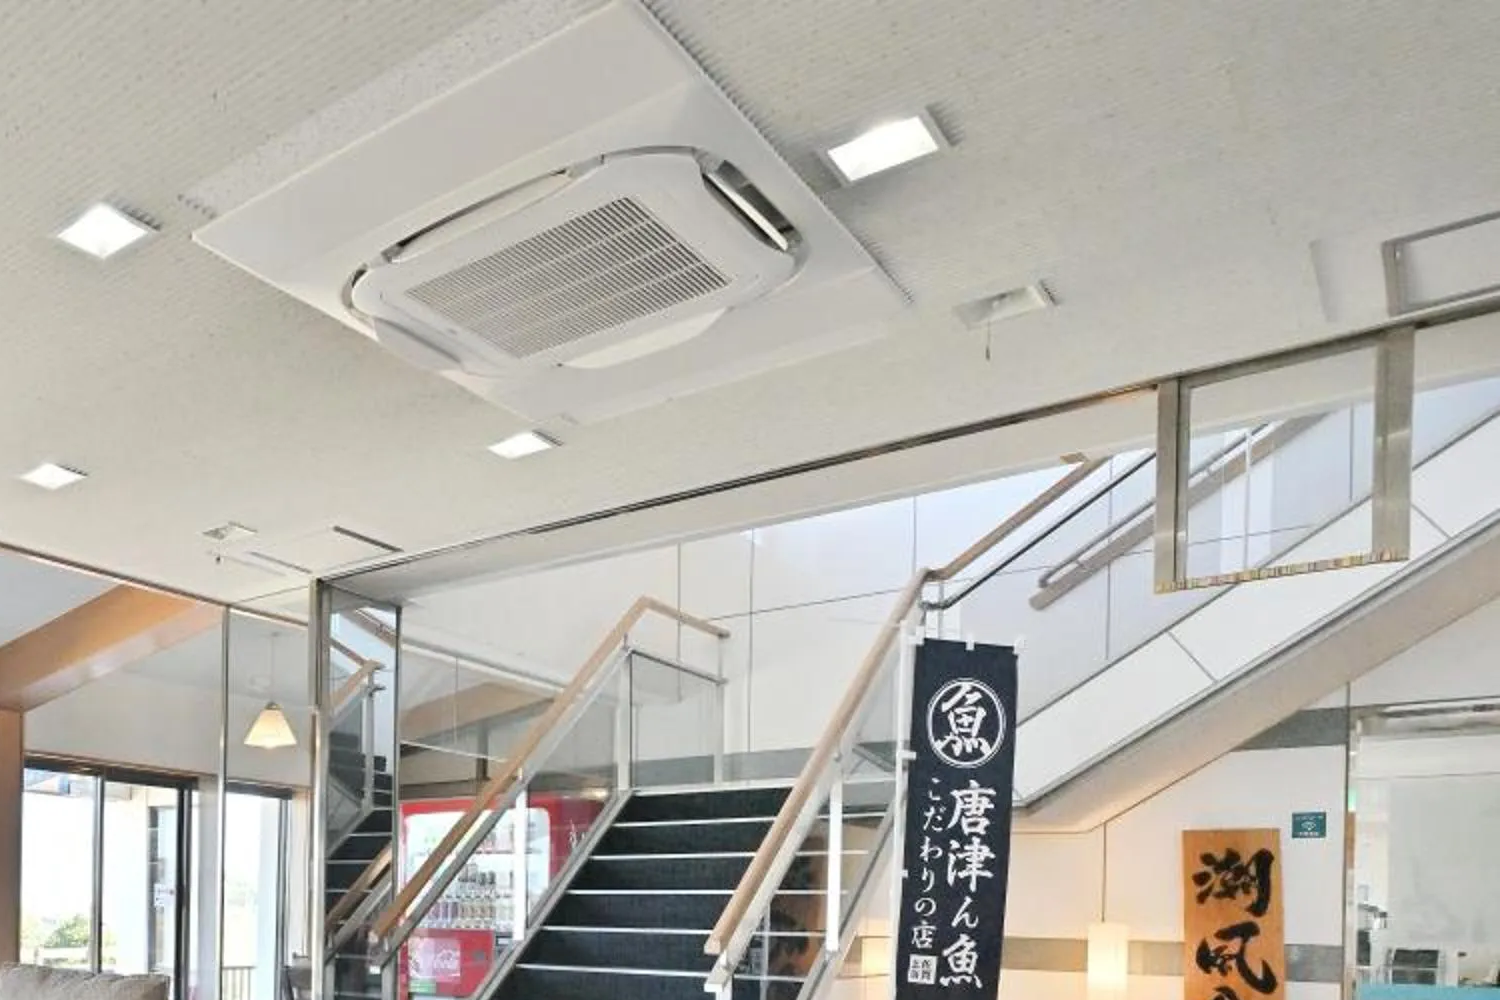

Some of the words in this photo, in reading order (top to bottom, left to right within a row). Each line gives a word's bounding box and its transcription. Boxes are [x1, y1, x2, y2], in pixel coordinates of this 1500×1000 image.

[911, 777, 946, 949] こだわりの店
[939, 779, 997, 989] 唐津ん魚
